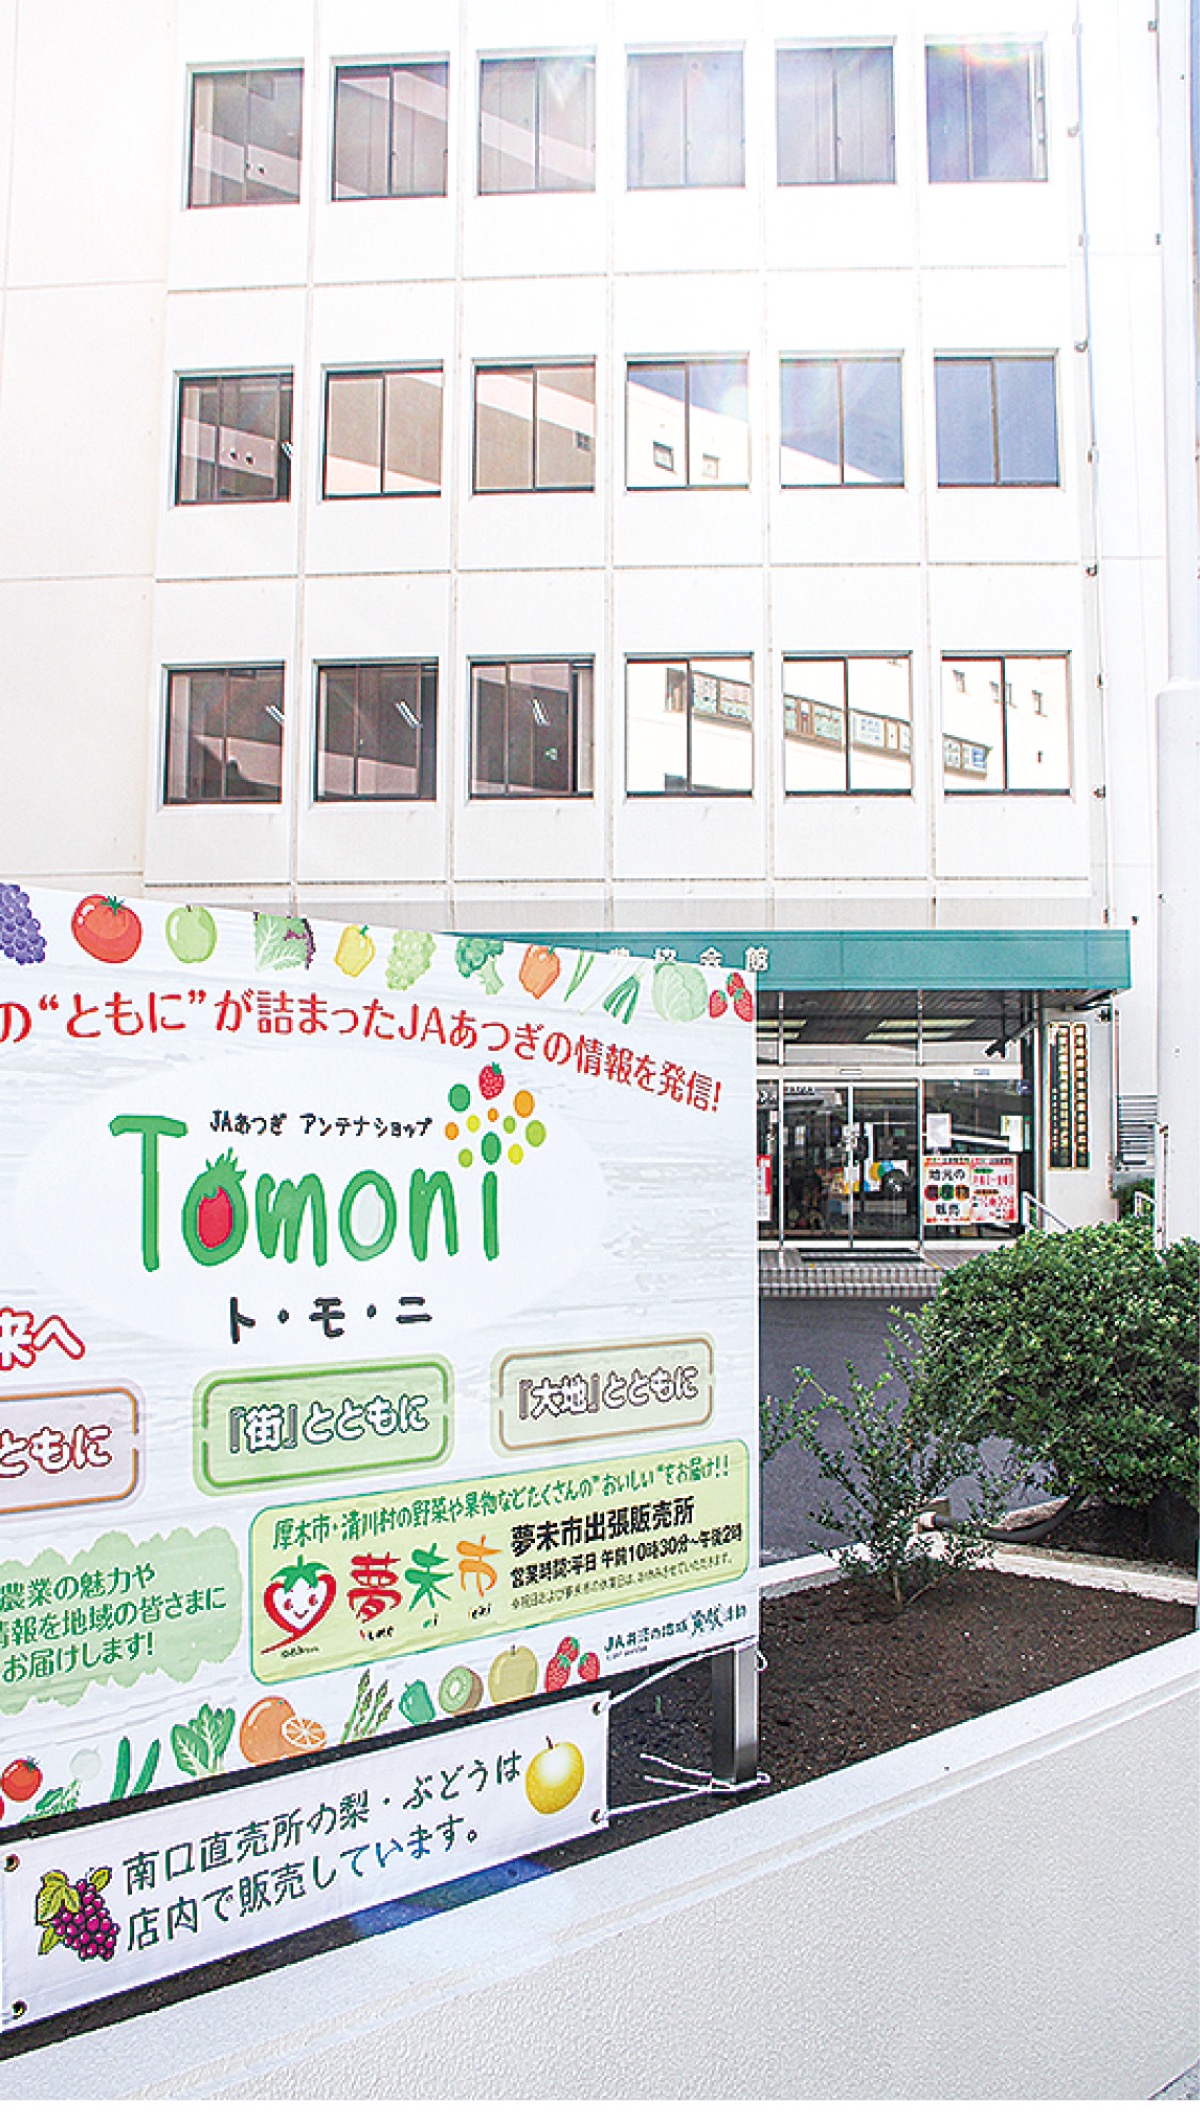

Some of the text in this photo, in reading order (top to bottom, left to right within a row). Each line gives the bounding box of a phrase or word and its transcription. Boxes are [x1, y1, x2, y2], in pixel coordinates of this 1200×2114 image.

[209, 1109, 433, 1138] JAあつぎ アンテナショップ
[108, 1113, 500, 1271] Tomoni
[230, 1296, 433, 1344] ト・モ・ニ
[518, 1365, 699, 1420] 『大地』とともに
[229, 1394, 429, 1453] 『街』とともに
[510, 1496, 695, 1557] 夢未市出張販売所
[2, 1631, 154, 1683] お届けします!
[121, 1750, 523, 1896] 南口直売所の梨・ぶどうは
[126, 1814, 480, 1952] 店内で販売しています。
